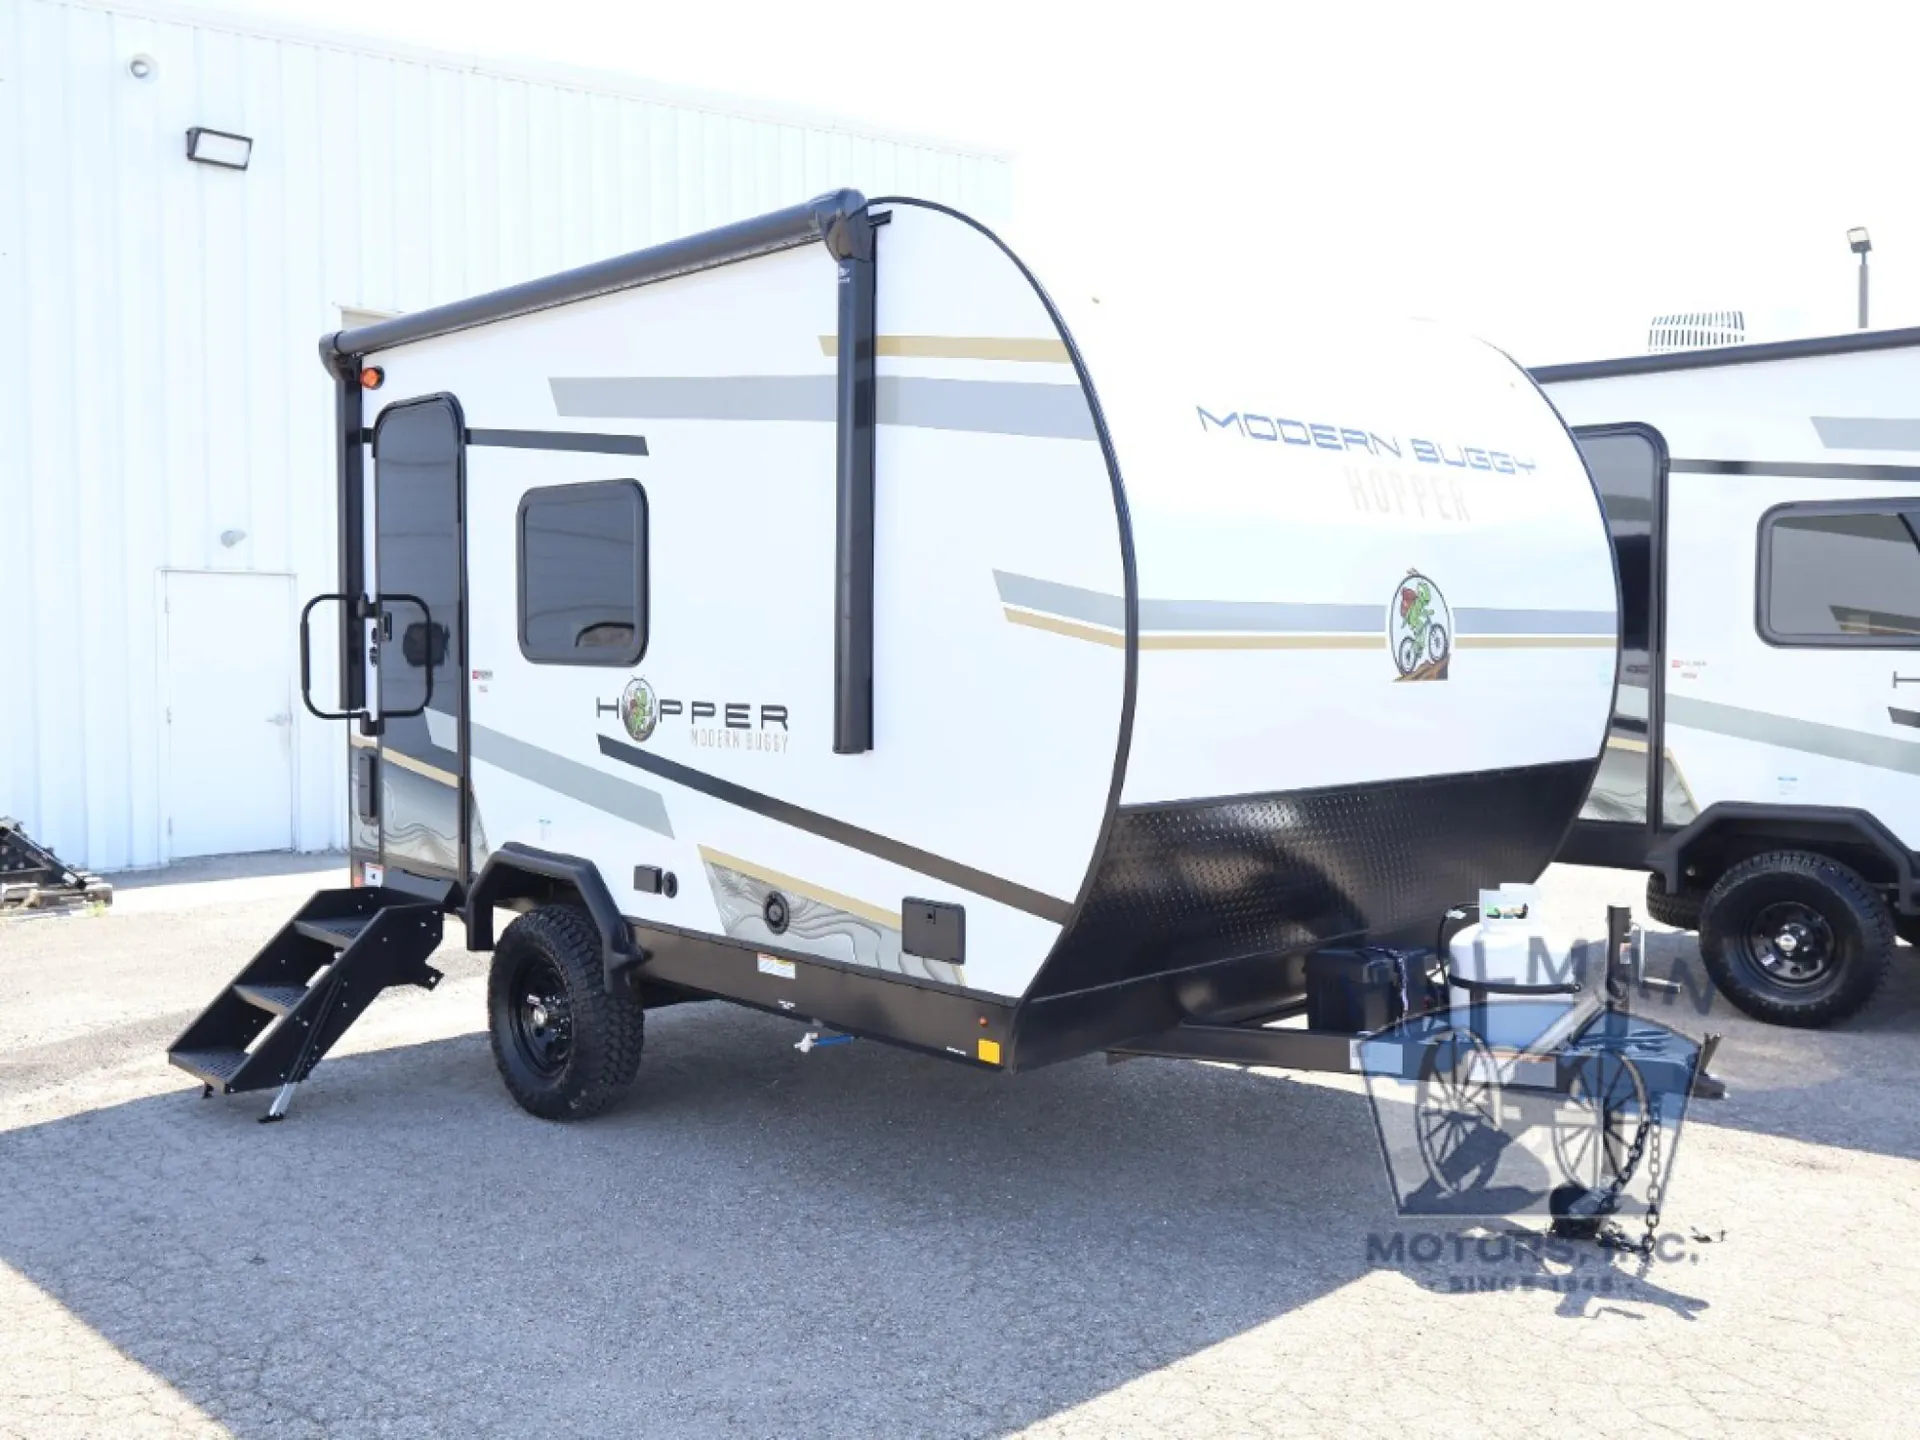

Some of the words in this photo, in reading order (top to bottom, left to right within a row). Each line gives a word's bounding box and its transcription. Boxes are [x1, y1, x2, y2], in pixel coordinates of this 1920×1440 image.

[1196, 404, 1404, 460] MODERN
[1411, 437, 1537, 476] BUGGY
[1342, 465, 1471, 523] HOPPER
[690, 727, 740, 750] MODERN
[745, 730, 789, 755] BUGGY
